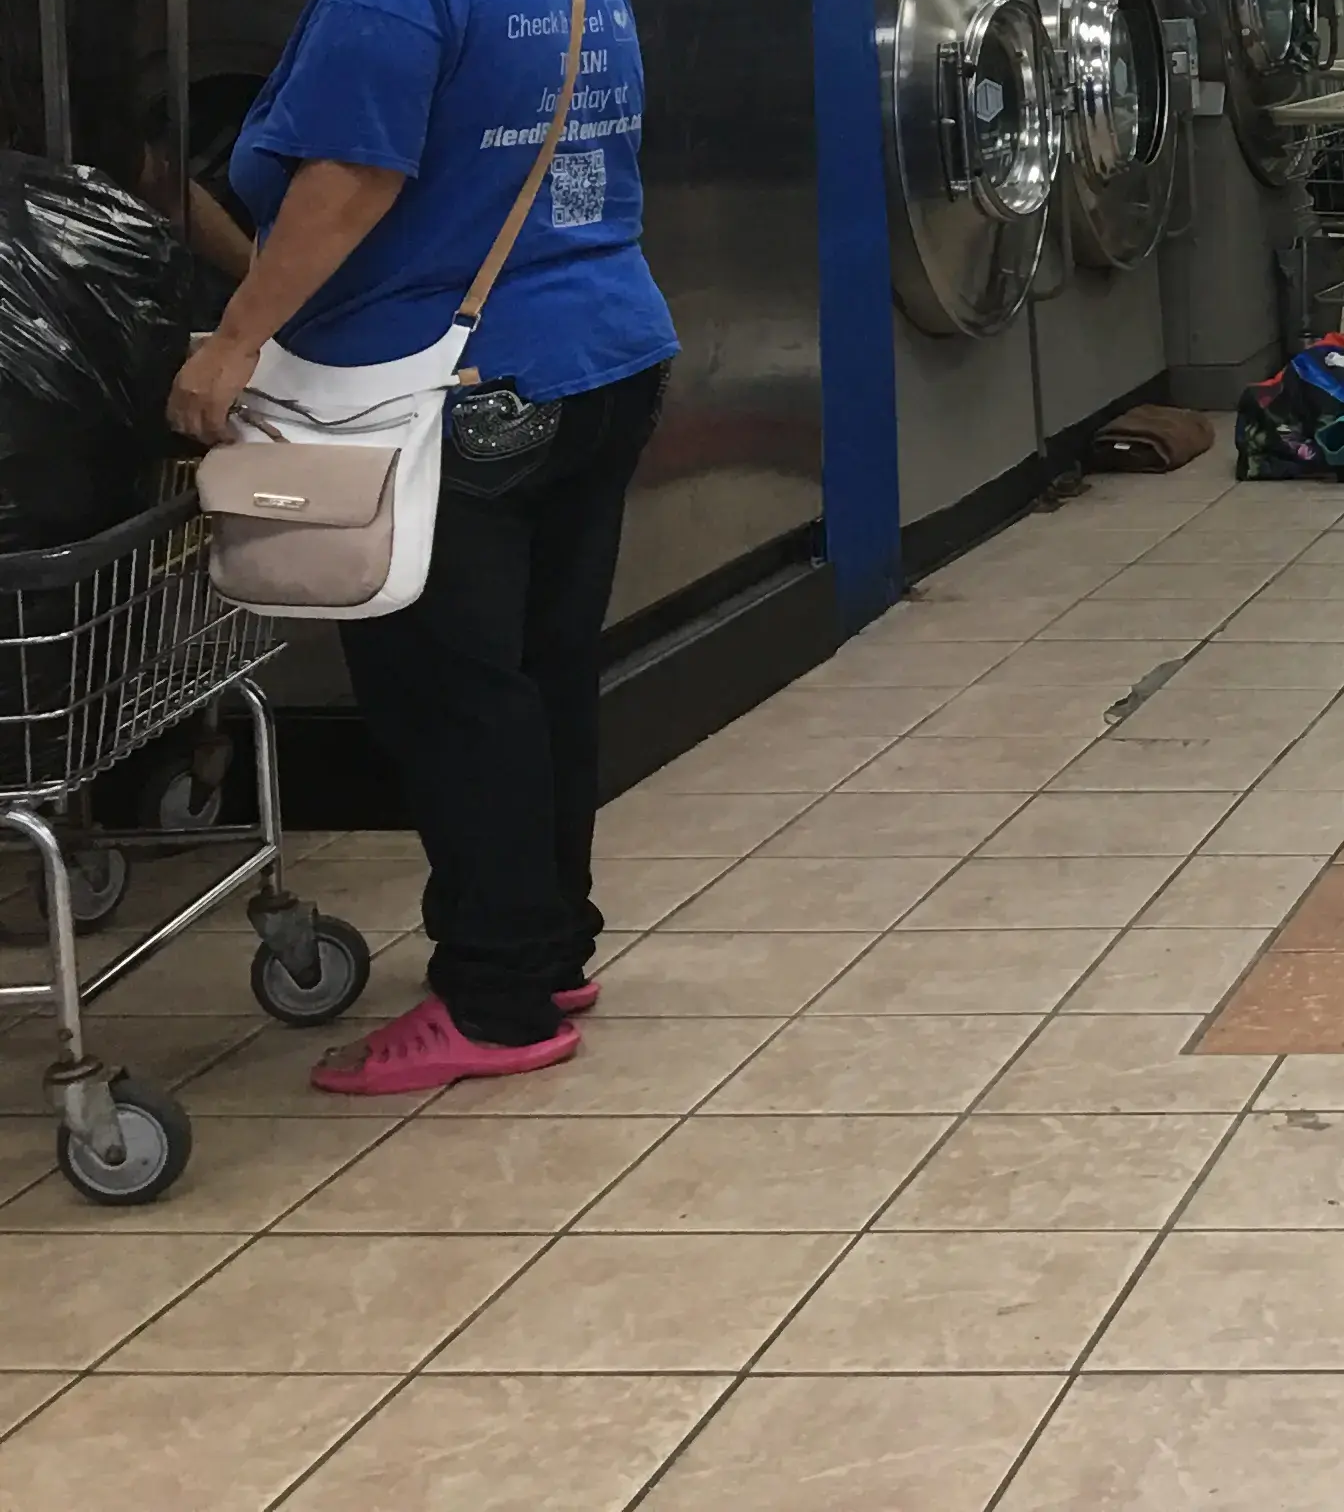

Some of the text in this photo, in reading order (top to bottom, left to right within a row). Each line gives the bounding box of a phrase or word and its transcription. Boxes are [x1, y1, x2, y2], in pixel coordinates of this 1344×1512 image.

[507, 9, 604, 39] Check hre!
[565, 85, 611, 112] oday
[614, 82, 628, 104] at
